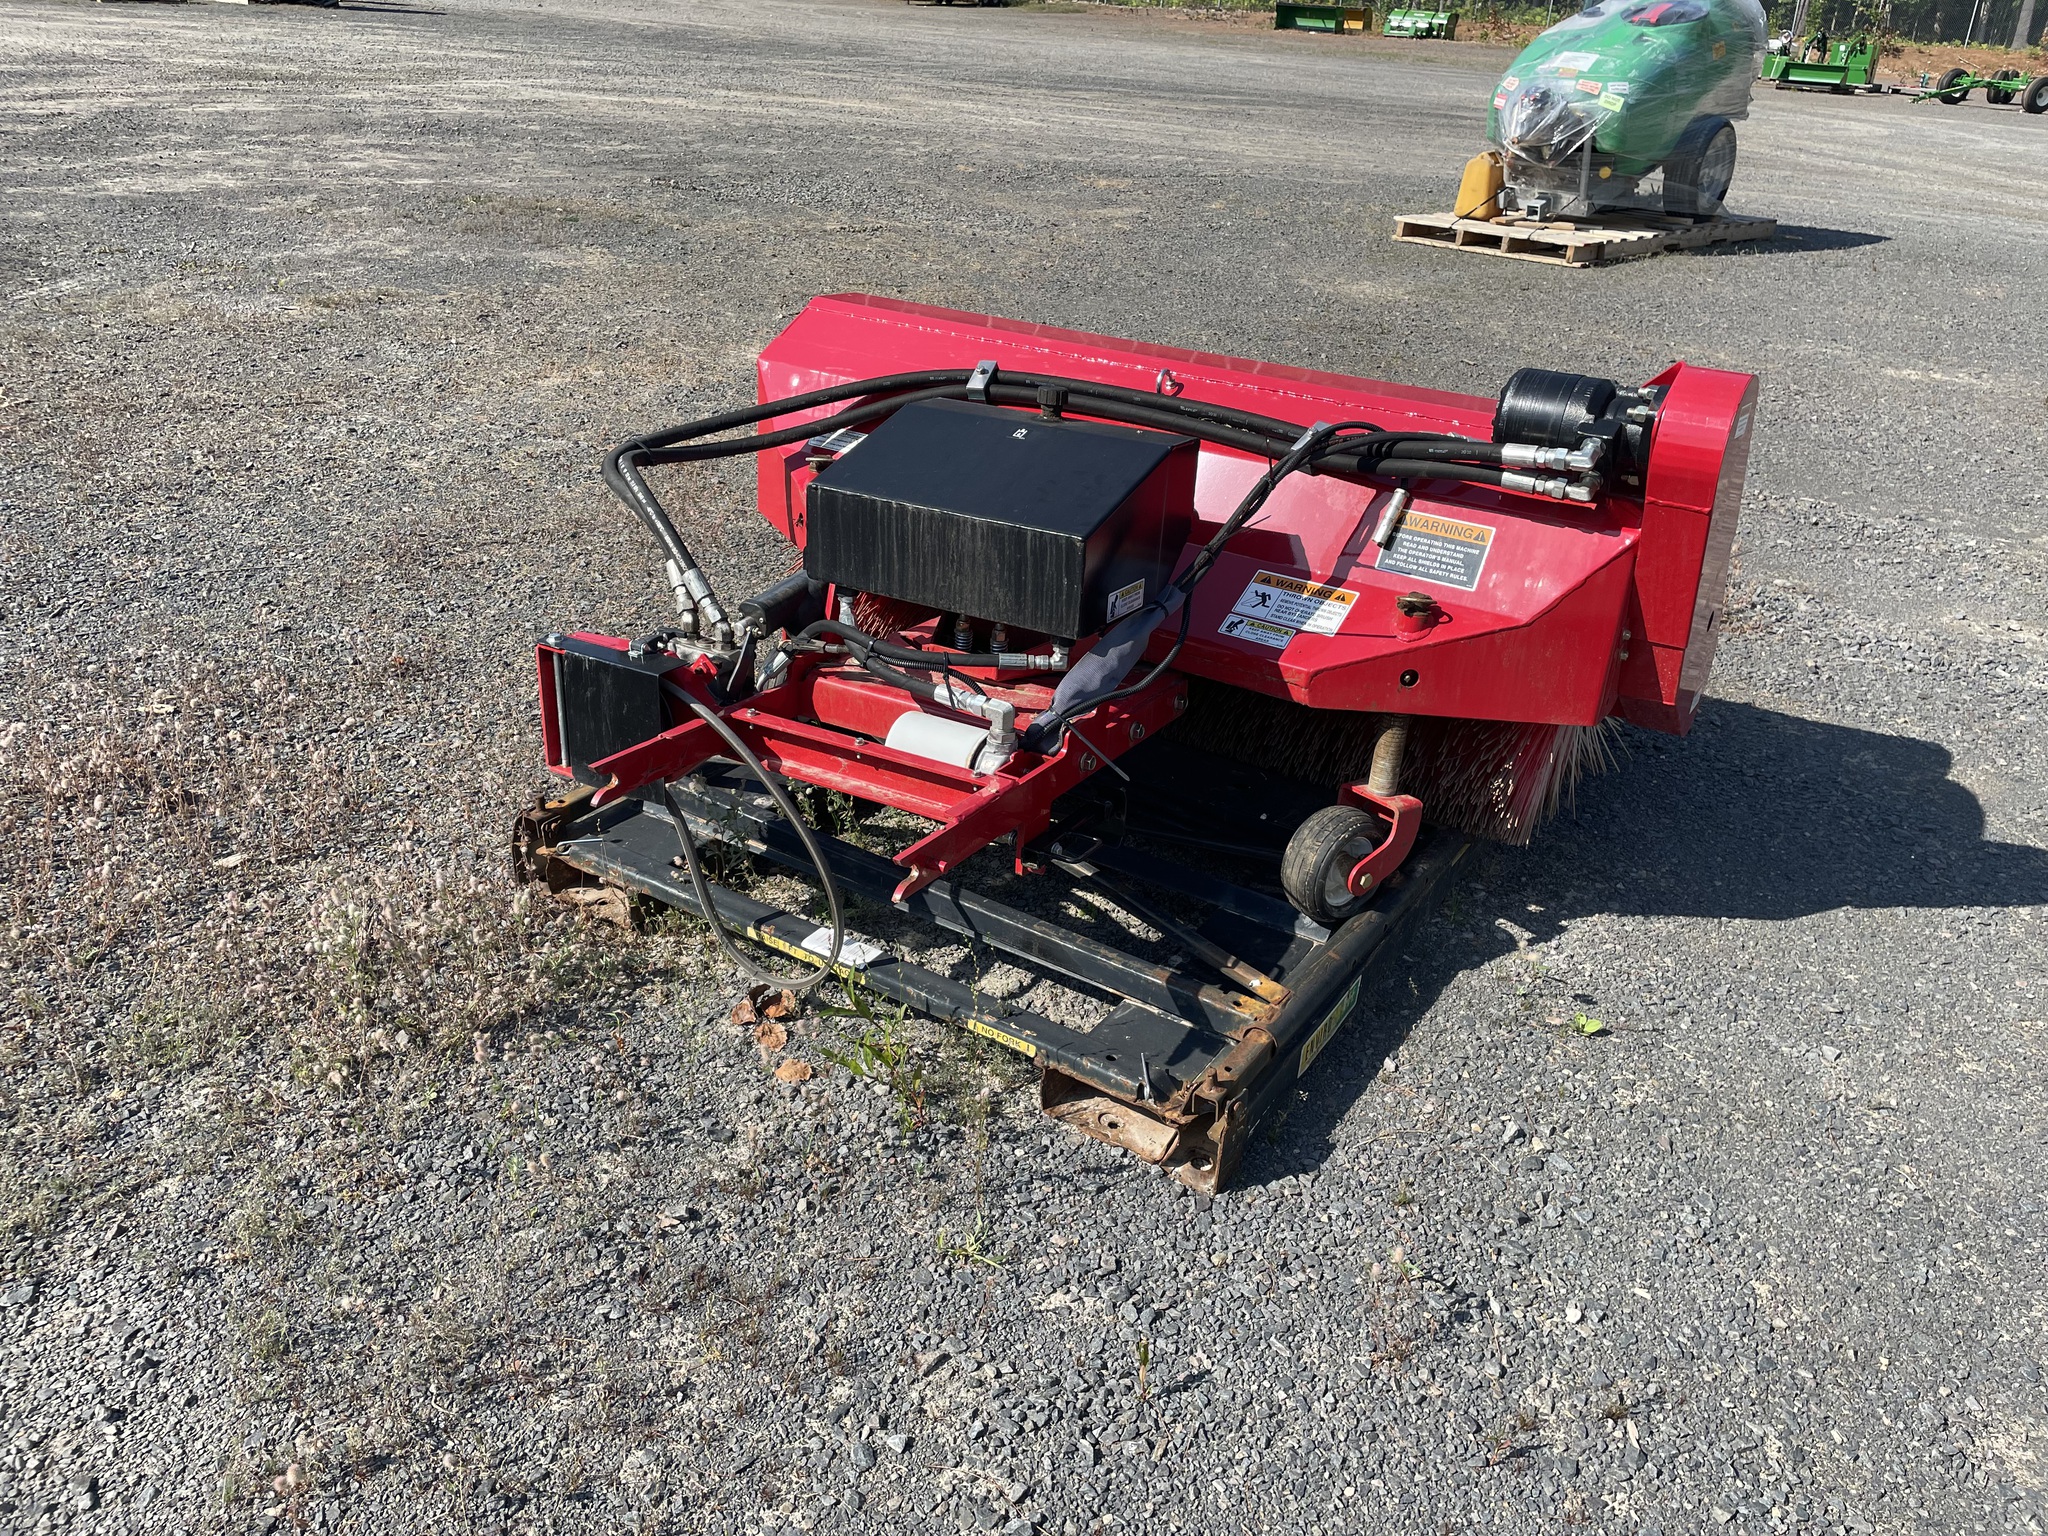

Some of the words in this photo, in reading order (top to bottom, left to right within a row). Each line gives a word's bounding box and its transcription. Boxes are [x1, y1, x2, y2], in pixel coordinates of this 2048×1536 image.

[1409, 516, 1474, 539] WARNING
[1413, 536, 1442, 546] OPERATING
[1456, 545, 1480, 555] MACHINE
[1430, 547, 1464, 558] UNDERSTAND
[1408, 550, 1440, 560] OPERATOR'S
[1396, 561, 1418, 570] FOLLOW
[1429, 569, 1450, 578] SAFETY
[1418, 559, 1440, 568] SHIELDS
[1447, 565, 1465, 574] PLACE
[1276, 579, 1333, 599] WARNING
[1282, 592, 1314, 602] THROWN
[1314, 600, 1346, 610] OBJECTS
[1257, 623, 1282, 633] CAUTION
[981, 1026, 994, 1036] NO
[996, 1033, 1021, 1048] FORK
